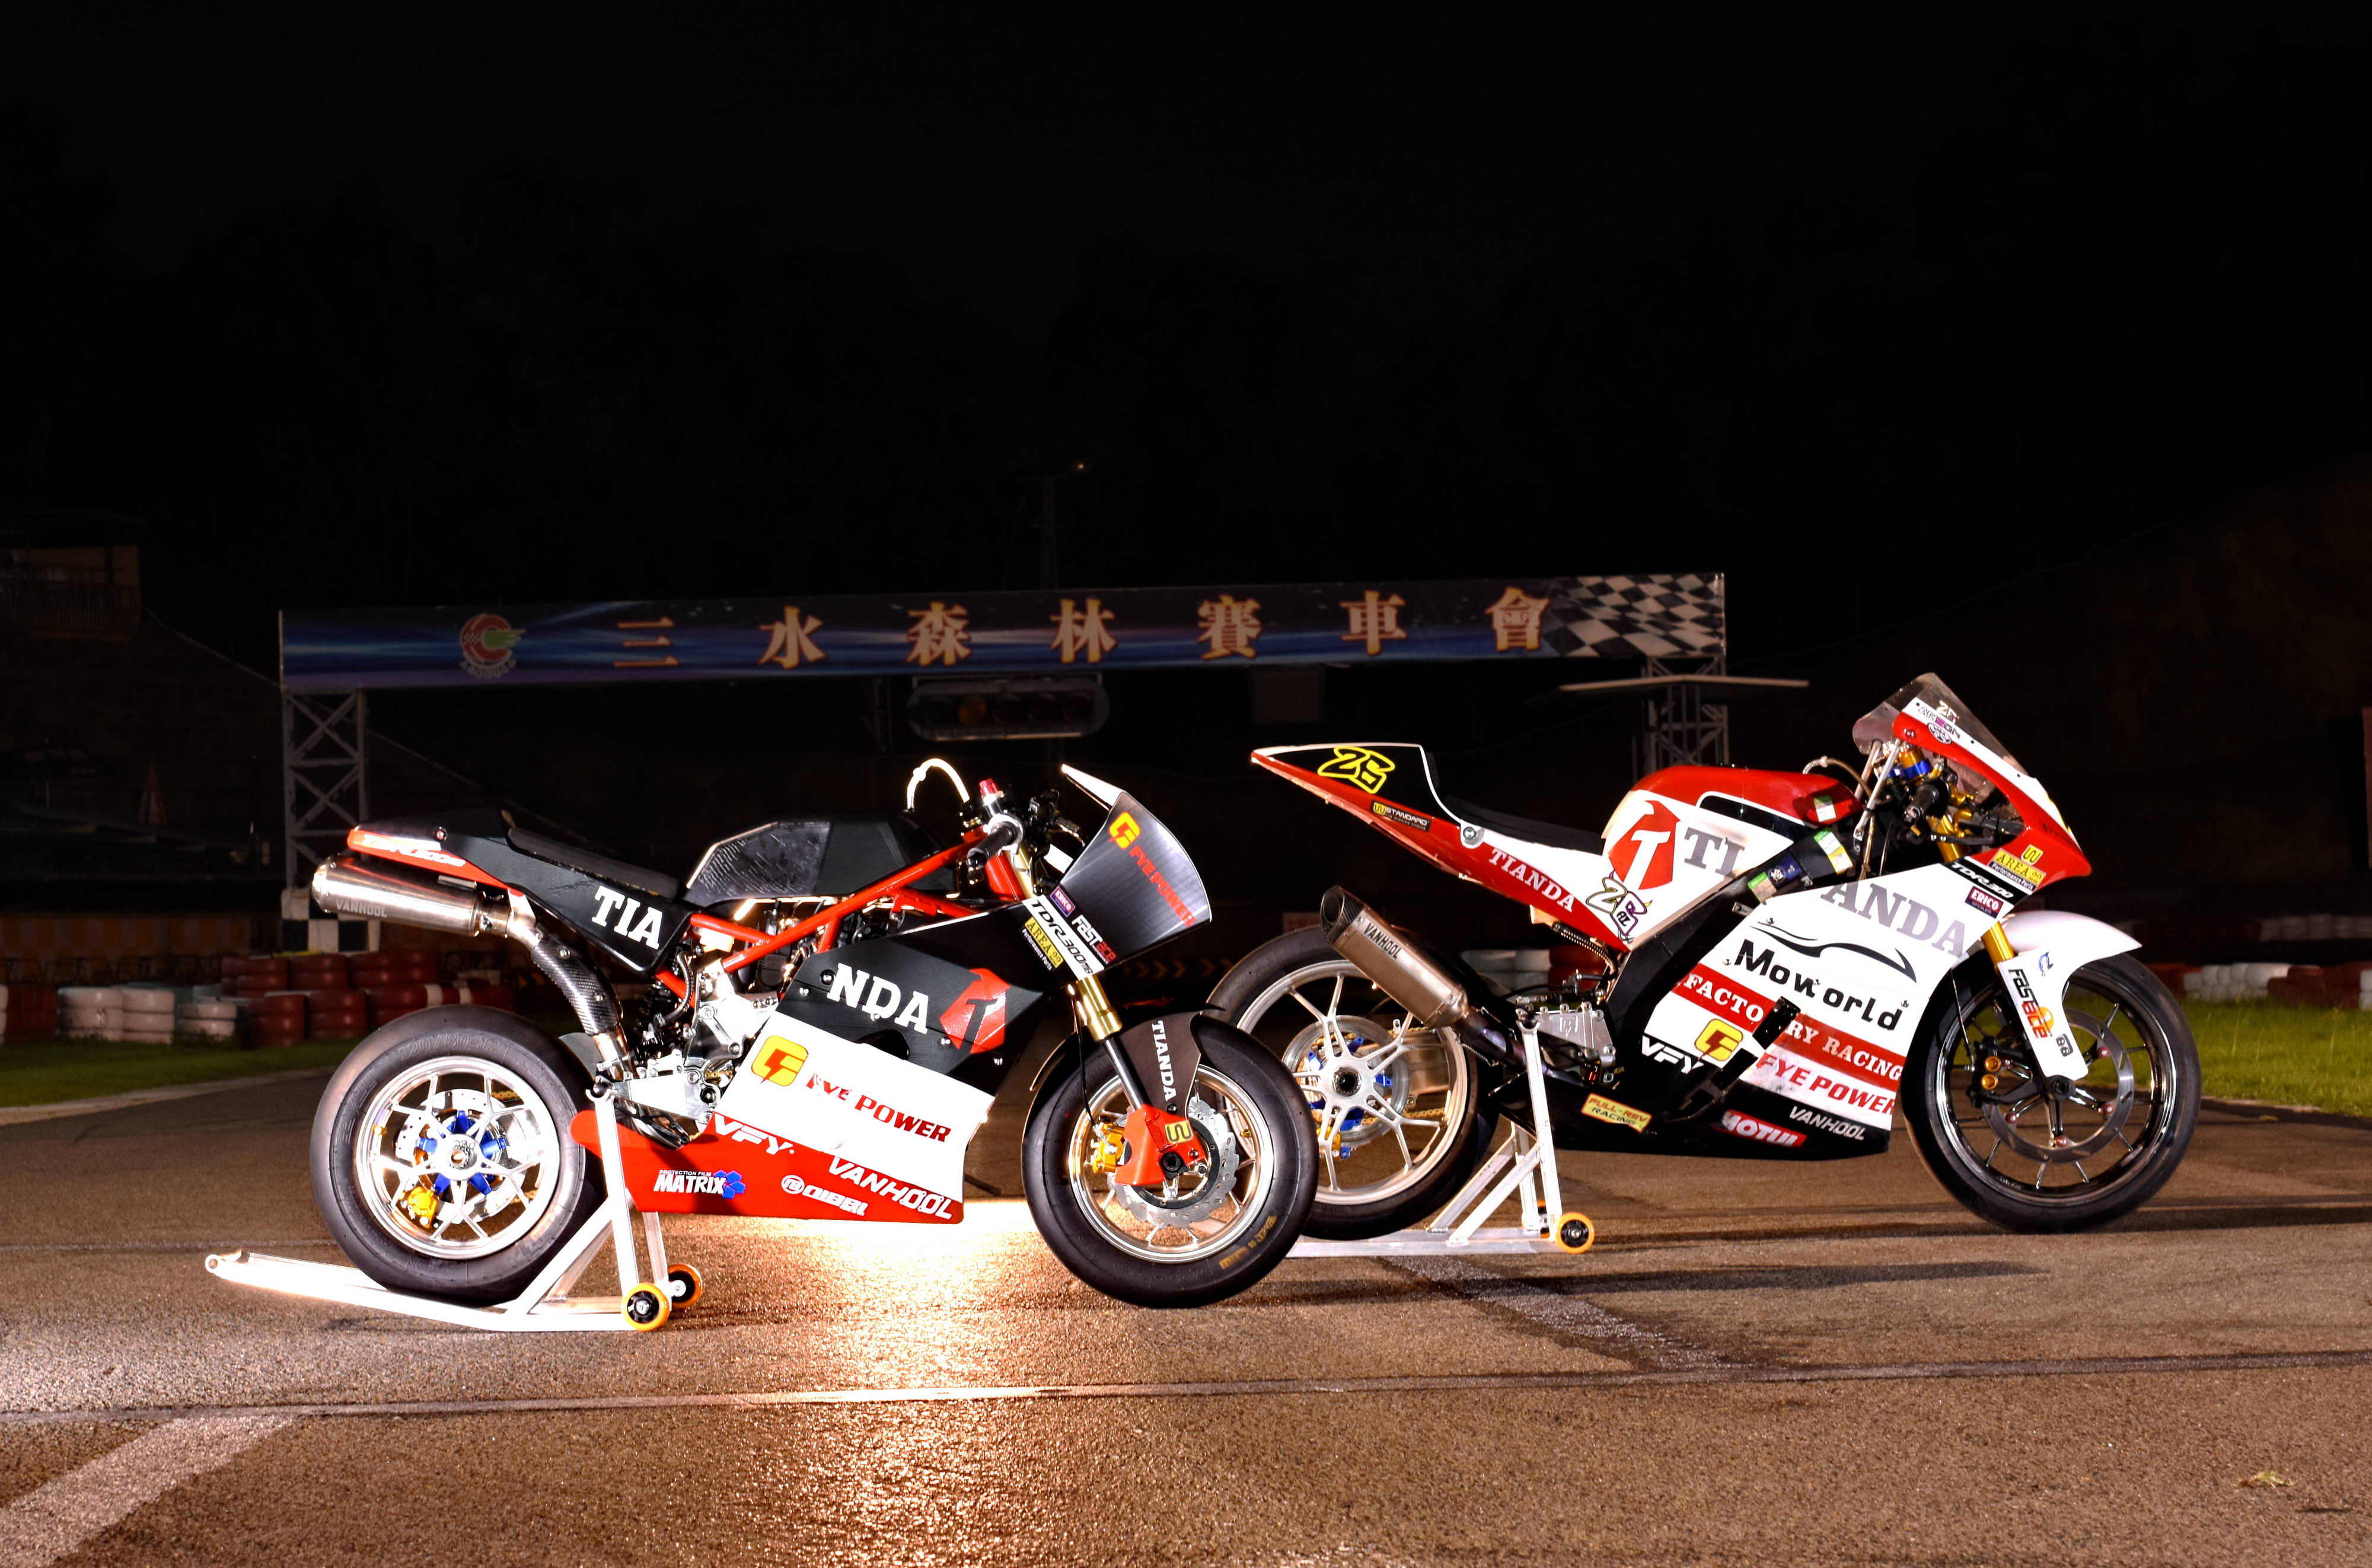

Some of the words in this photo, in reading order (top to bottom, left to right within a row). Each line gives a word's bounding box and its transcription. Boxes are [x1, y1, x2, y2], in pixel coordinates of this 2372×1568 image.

[1488, 847, 1577, 913] TIANDA
[1995, 853, 2029, 878] AREA
[335, 898, 388, 918] VANHOOL
[592, 885, 664, 949] TIA
[1971, 889, 1999, 911] ERICO
[1021, 928, 1043, 958] Performance
[1041, 955, 1053, 971] Parts
[1026, 921, 1052, 954] AREA
[1049, 952, 1061, 965] 22
[1364, 923, 1401, 960] VANHOOL
[826, 963, 929, 1035] NDA
[1151, 1019, 1177, 1102] TIANDA
[1822, 1036, 1905, 1081] RACING
[1809, 1075, 1896, 1116] POWER
[713, 1113, 795, 1156] VFY
[854, 1094, 952, 1143] POWER
[1788, 1105, 1867, 1141] VANHOOL
[653, 1174, 726, 1194] MATRIX
[828, 1155, 953, 1220] VANHOOL
